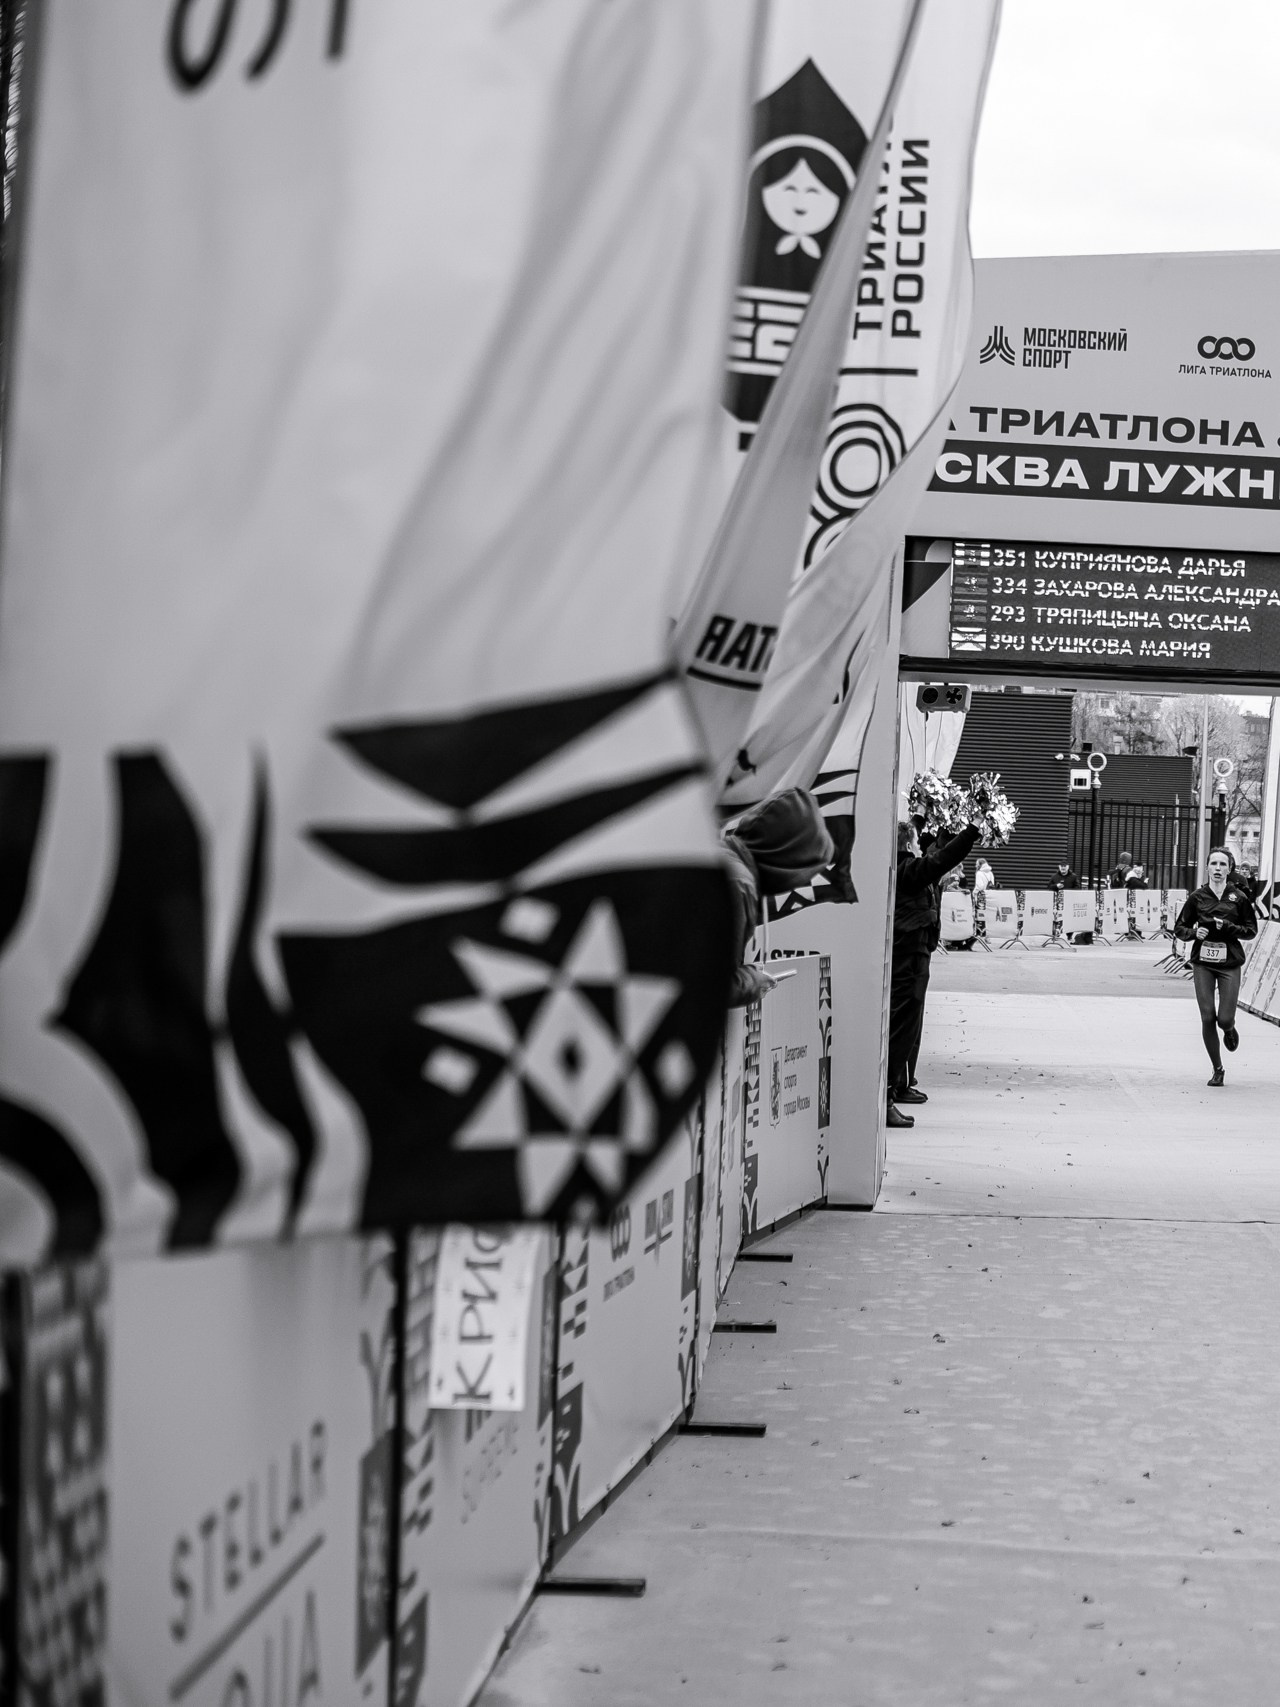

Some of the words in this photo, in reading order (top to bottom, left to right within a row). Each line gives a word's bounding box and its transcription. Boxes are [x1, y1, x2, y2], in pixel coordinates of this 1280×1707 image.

[891, 139, 930, 338] РОССИИ
[1023, 327, 1128, 352] МОСКОВСКИЙ
[1022, 348, 1072, 369] СПОРТ
[1178, 364, 1206, 375] ЛИГА
[1209, 366, 1272, 379] ТРИАТЛОНА
[970, 406, 1265, 448] ТРИАТЛОНА
[935, 451, 1088, 490] СКВА
[1178, 557, 1246, 579] ДАРЬЯ
[1034, 579, 1138, 600] ЗАХАРОВА
[1144, 584, 1280, 609] АЛЕКСАНДРА
[1168, 613, 1252, 632] ОКСАНА
[1031, 636, 1133, 656] КУШКОВА
[1140, 640, 1210, 658] МАРИЯ
[1206, 948, 1220, 958] 337
